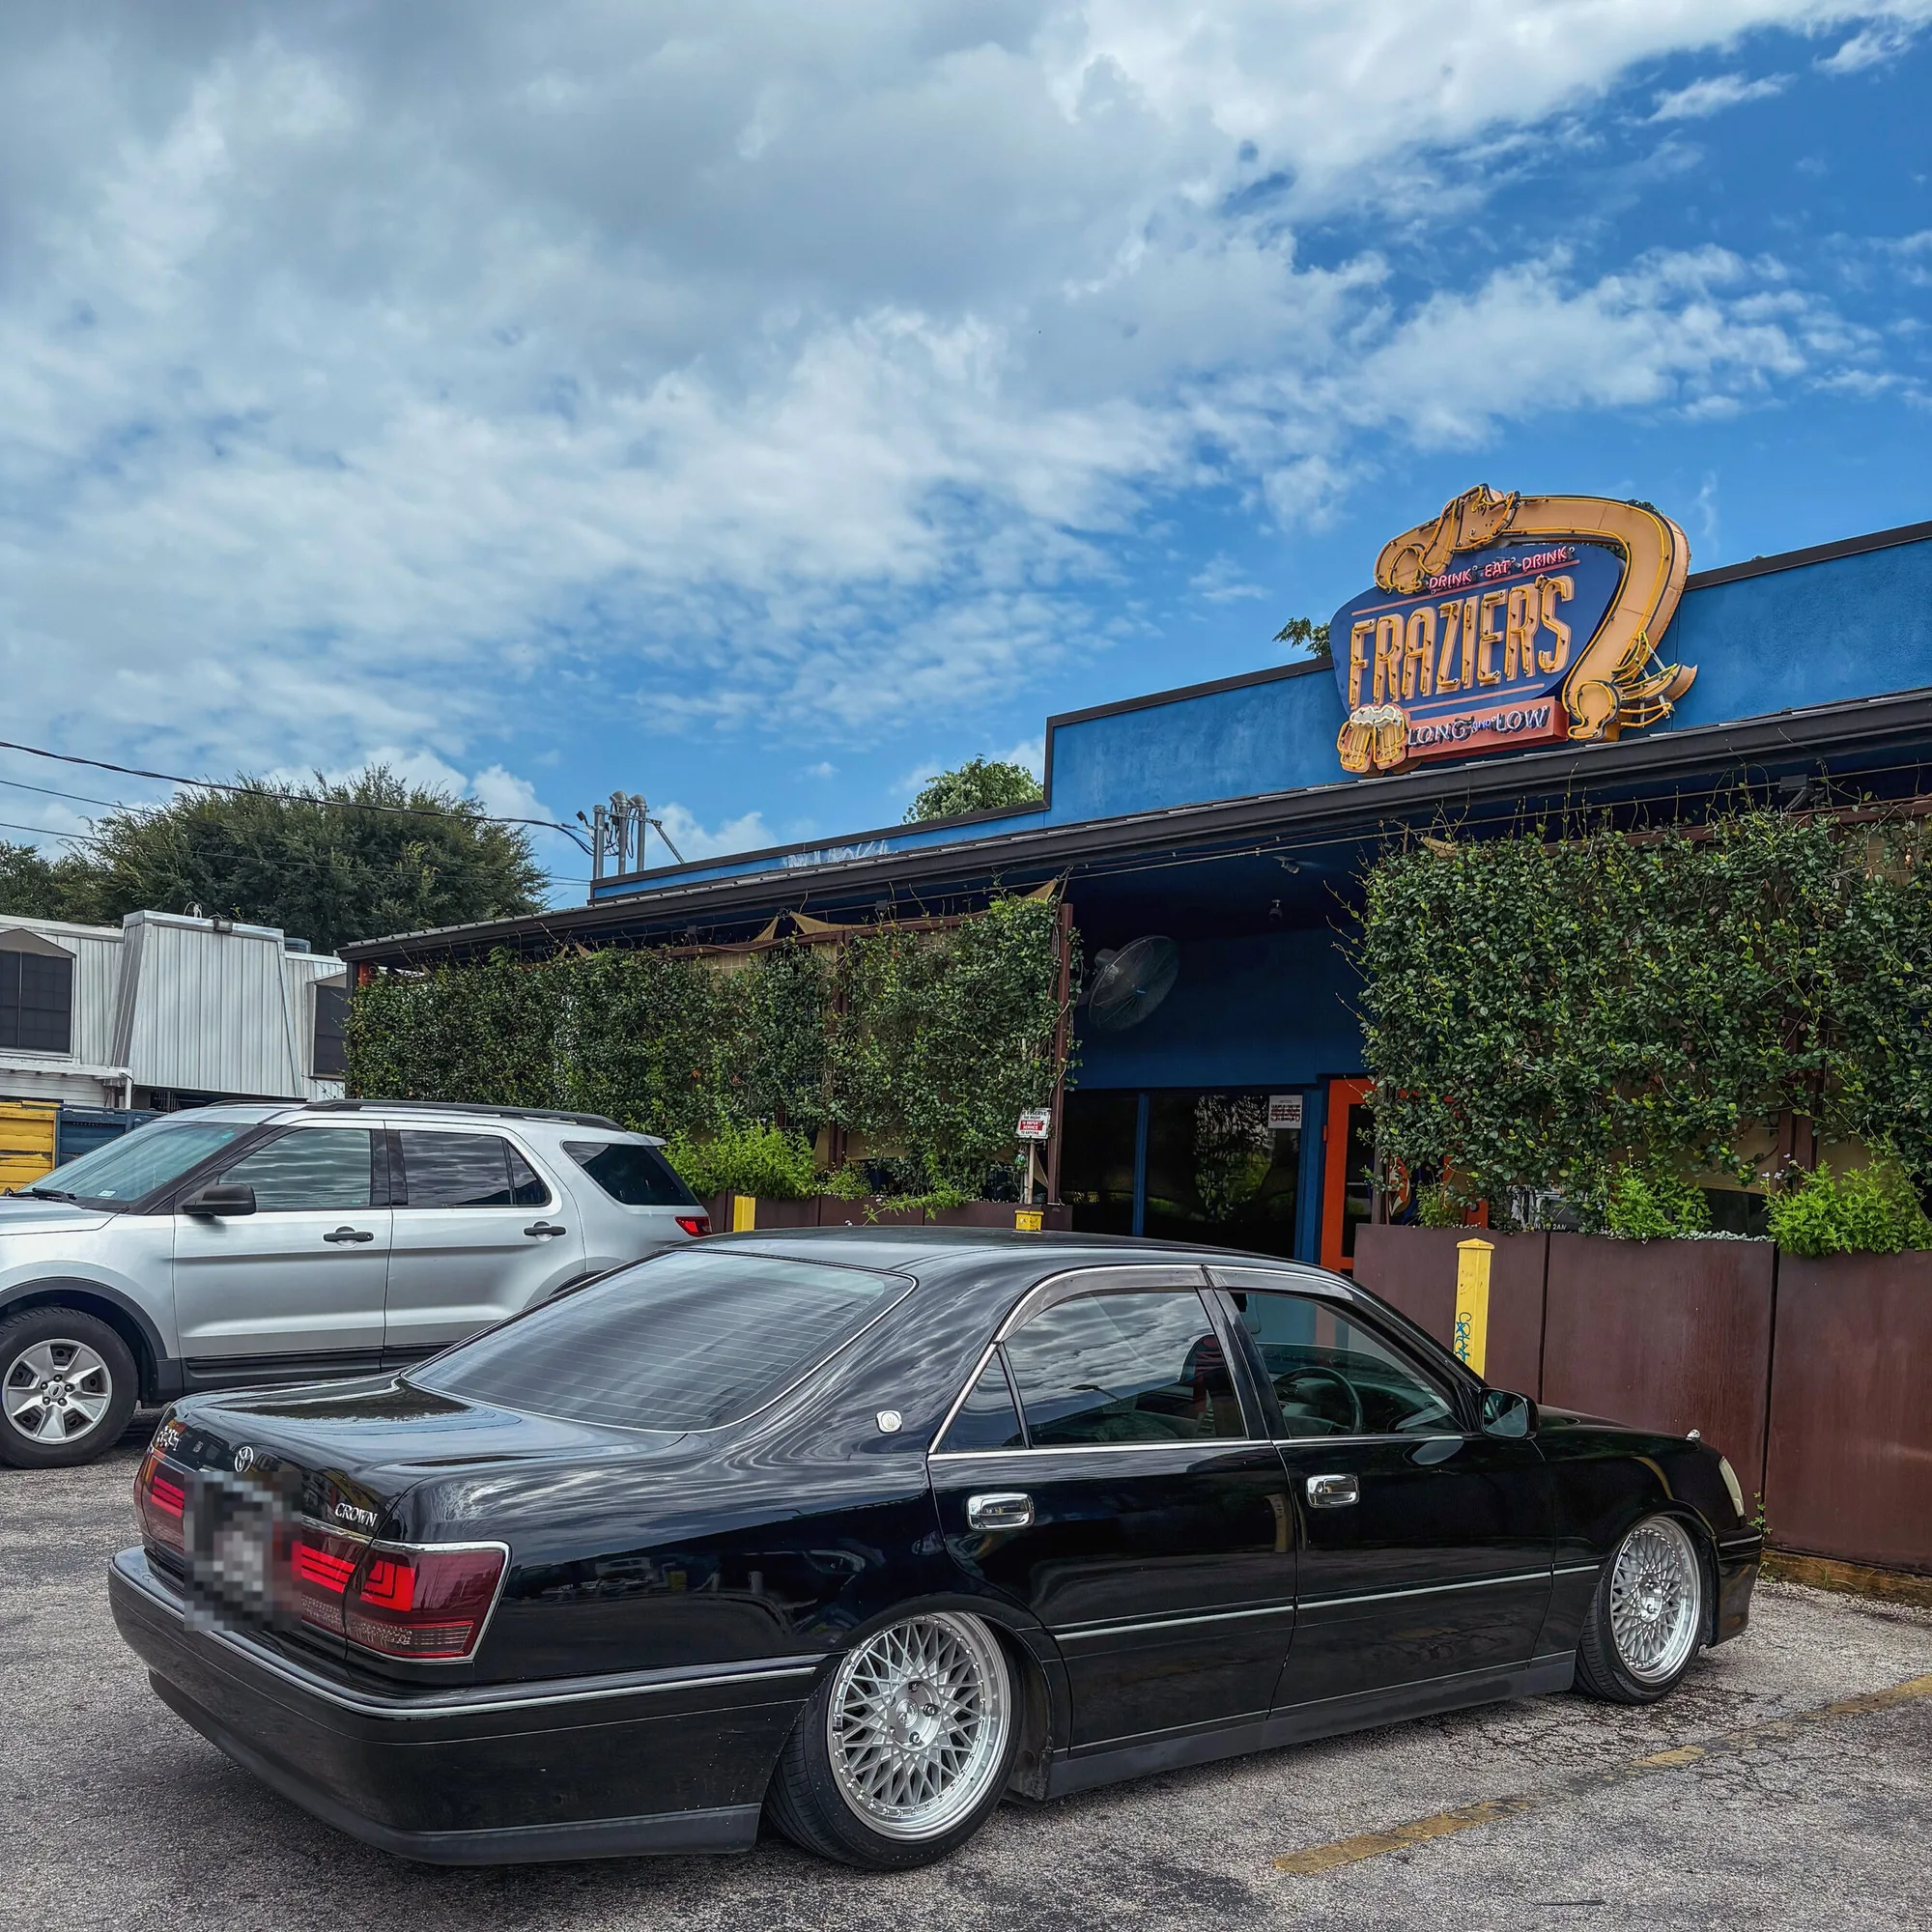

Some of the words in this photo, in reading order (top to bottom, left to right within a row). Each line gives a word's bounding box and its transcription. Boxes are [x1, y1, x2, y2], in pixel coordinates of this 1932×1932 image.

[1428, 568, 1472, 590] DRINK
[1484, 560, 1512, 579] EAT
[1521, 546, 1568, 573] DRINK
[1408, 718, 1474, 747] LONG
[1496, 706, 1550, 733] LOW
[335, 1502, 378, 1527] CROWN
